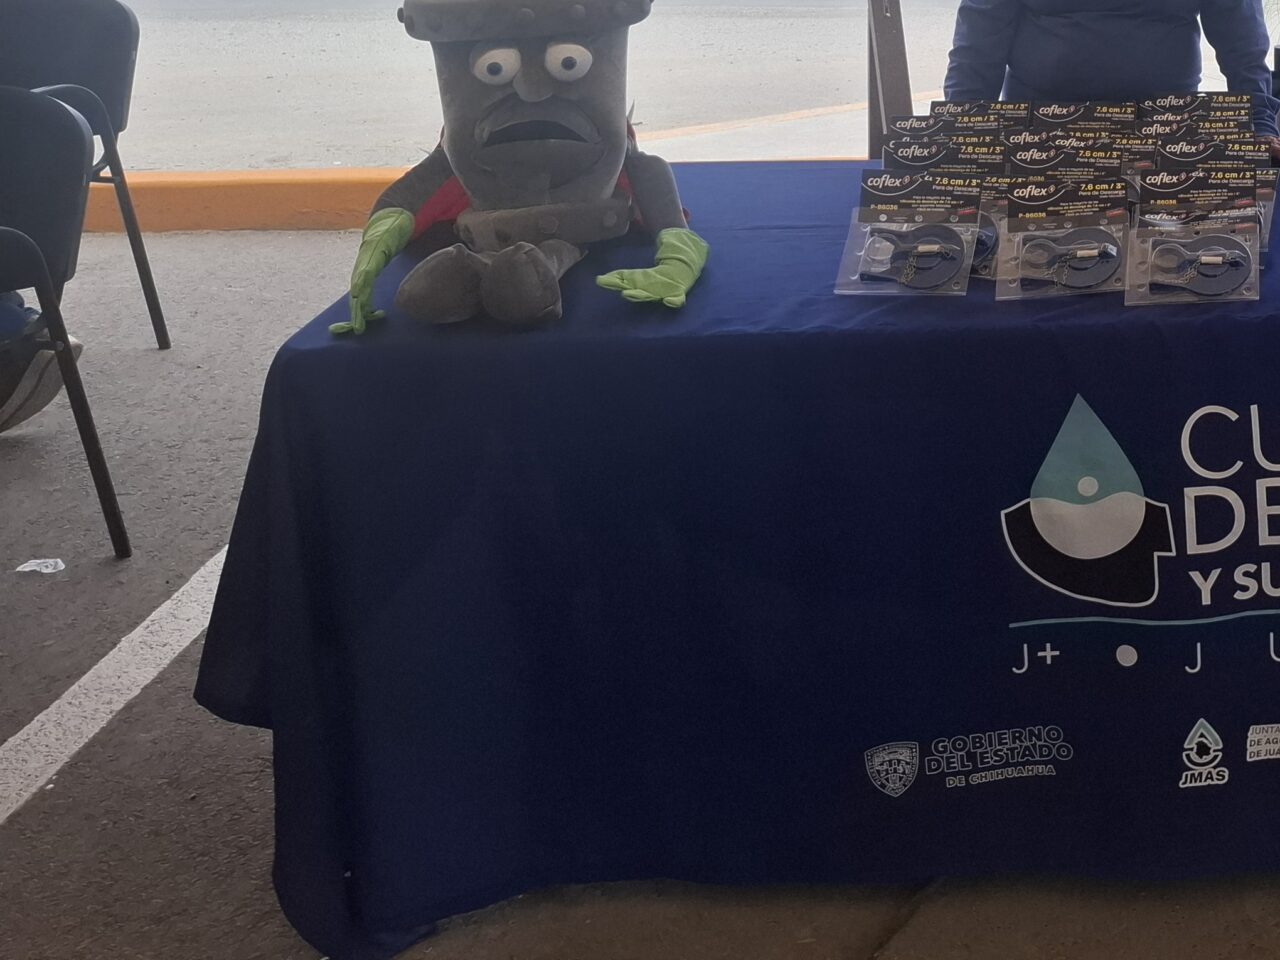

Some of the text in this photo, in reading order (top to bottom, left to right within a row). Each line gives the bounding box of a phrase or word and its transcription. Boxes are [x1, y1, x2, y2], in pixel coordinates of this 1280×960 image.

[1156, 96, 1184, 108] coflex
[934, 104, 962, 116] coflex
[1040, 104, 1068, 116] coflex
[896, 118, 927, 129] coflex
[1142, 124, 1171, 136] coflex
[1010, 132, 1040, 144] coflex
[1056, 138, 1086, 149] coflex
[898, 145, 930, 158] coflex
[1166, 142, 1197, 154] coflex
[1016, 148, 1048, 162] coflex
[868, 174, 902, 188] coflex
[1146, 172, 1178, 185] coflex
[1014, 185, 1048, 198] coflex
[1188, 566, 1222, 605] Y
[1012, 642, 1060, 674] J+
[1250, 726, 1280, 736] JUNTA
[932, 726, 1064, 756] GOBIERNO
[1249, 738, 1262, 748] DE
[925, 752, 972, 774] DEL
[978, 742, 1073, 768] ESTADO
[1249, 750, 1262, 759] DE
[946, 765, 1056, 788] DE CHIHUAHUA
[1181, 768, 1228, 787] JMAS
